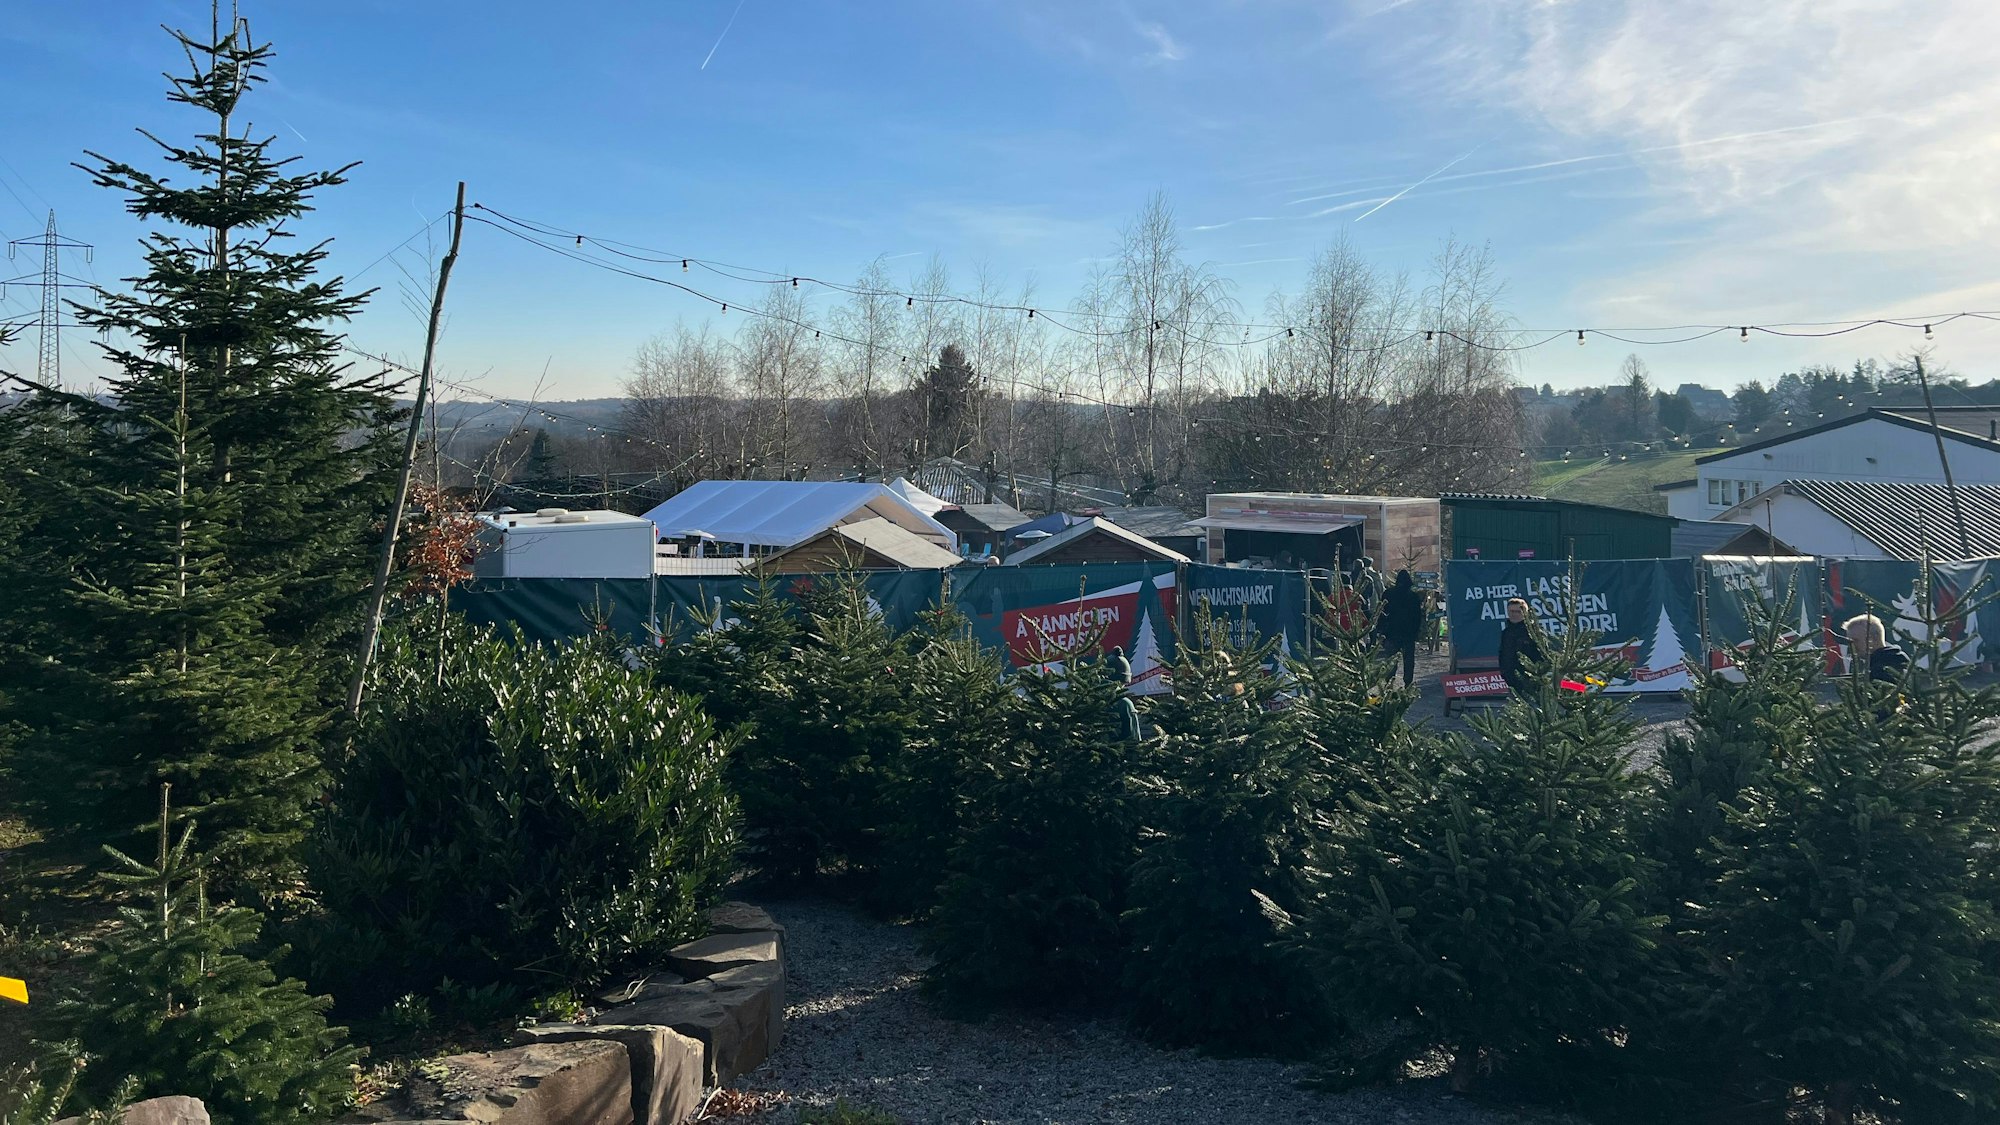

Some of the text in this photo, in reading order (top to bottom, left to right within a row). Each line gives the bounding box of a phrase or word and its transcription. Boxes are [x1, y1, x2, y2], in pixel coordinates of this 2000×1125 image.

[1465, 587, 1483, 600] AB
[1525, 576, 1571, 596] LASS
[1480, 600, 1512, 620] ALL
[1016, 618, 1028, 638] Ä
[1578, 612, 1618, 633] DIR!
[1454, 684, 1487, 693] SORGEN
[1469, 676, 1488, 685] LASS
[1490, 674, 1505, 682] ALL
